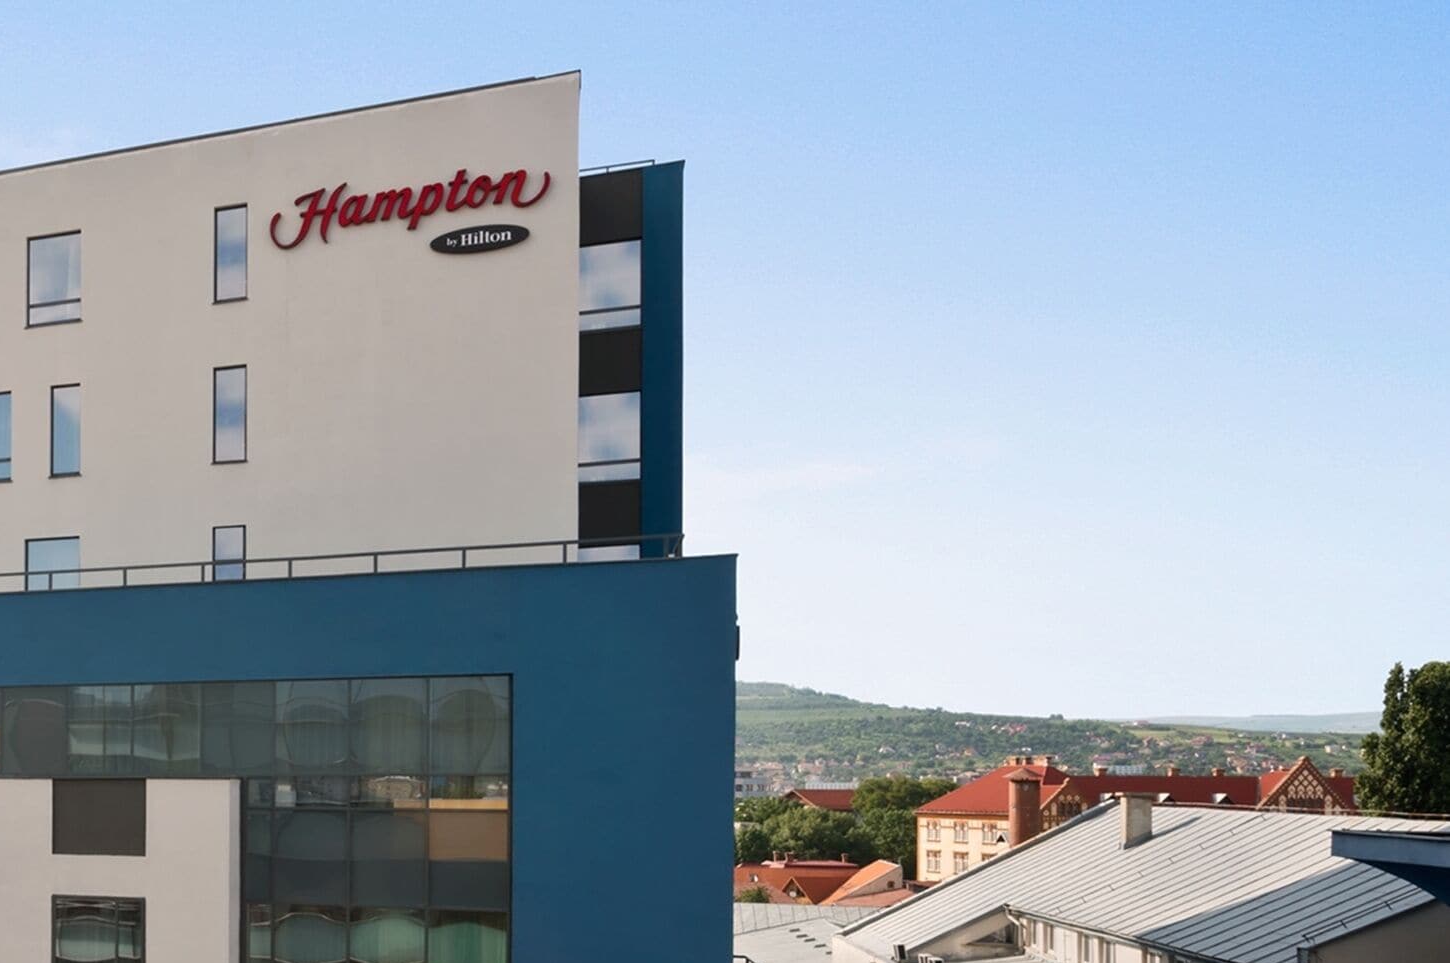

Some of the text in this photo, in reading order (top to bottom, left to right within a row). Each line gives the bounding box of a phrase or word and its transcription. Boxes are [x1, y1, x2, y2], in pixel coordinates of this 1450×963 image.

[270, 168, 551, 250] Hampton
[446, 230, 512, 247] by Hilton
